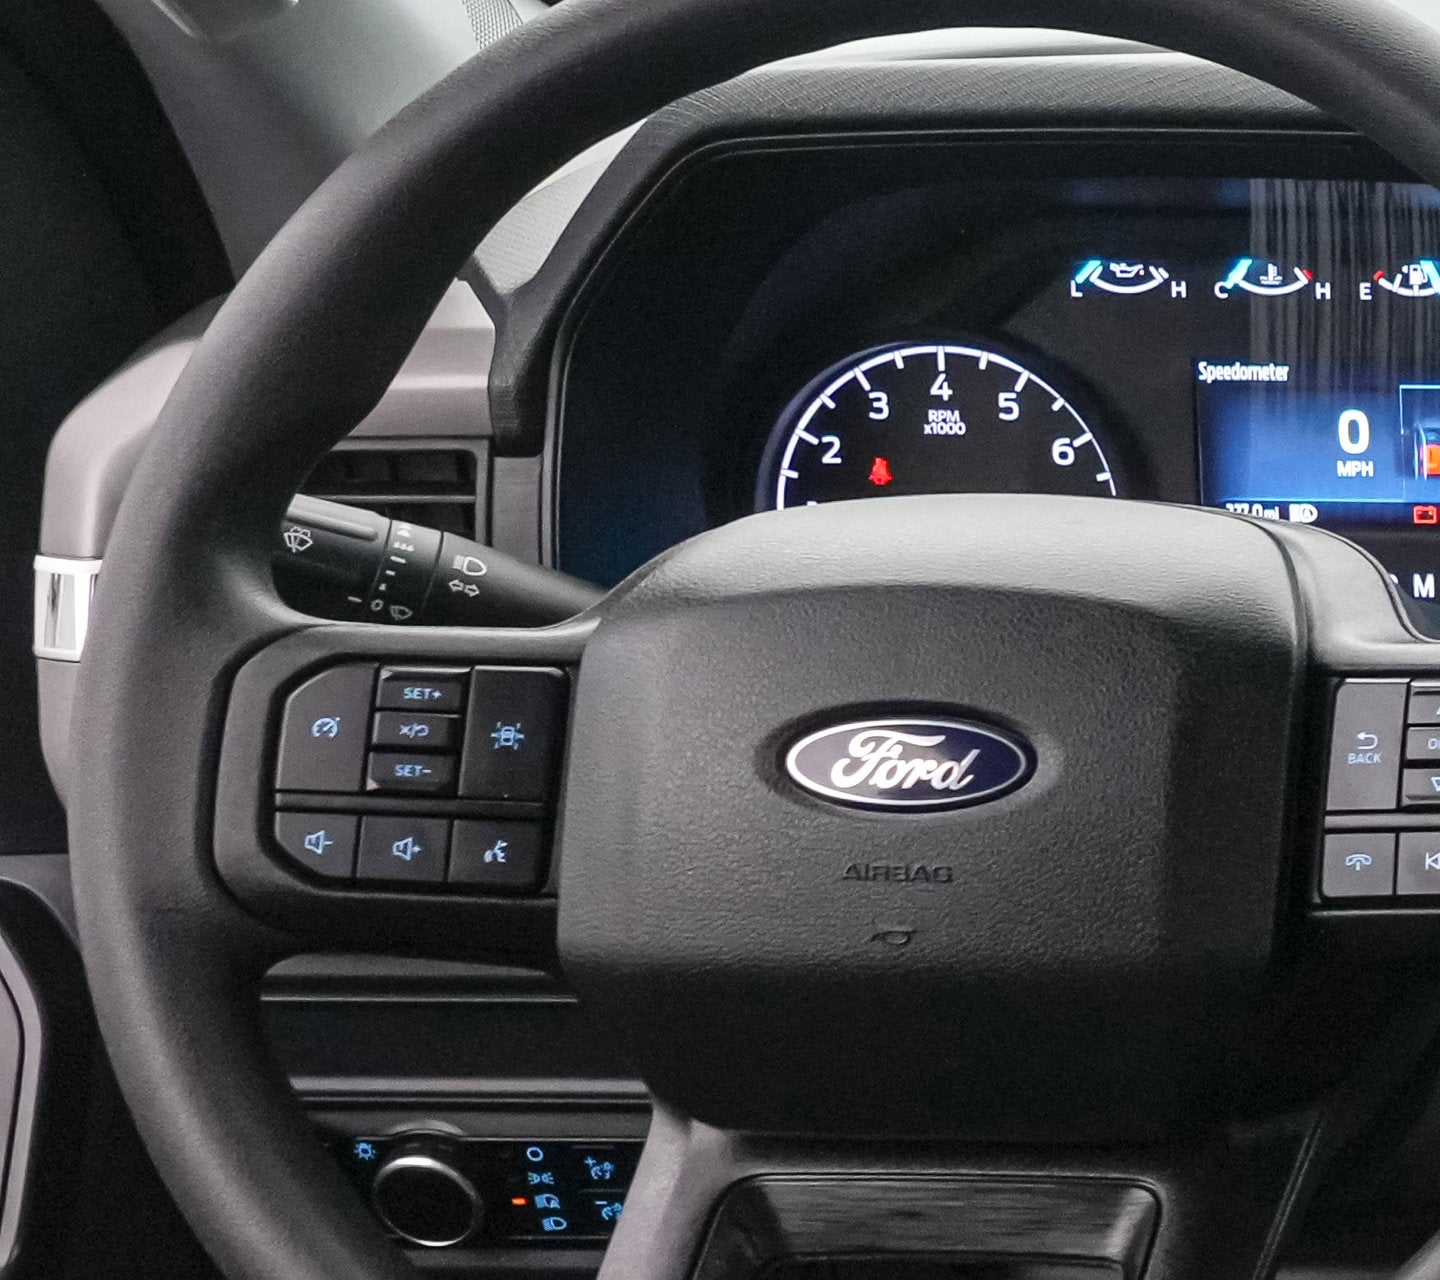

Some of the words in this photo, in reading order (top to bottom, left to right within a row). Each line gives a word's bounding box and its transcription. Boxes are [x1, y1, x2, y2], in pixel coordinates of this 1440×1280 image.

[1070, 281, 1083, 298] L
[1171, 281, 1186, 297] H
[1316, 282, 1330, 299] H
[1360, 283, 1372, 300] E
[1198, 362, 1289, 383] Speedometer
[930, 373, 952, 401] 4
[866, 390, 889, 419] 3
[928, 409, 960, 422] RPM
[998, 391, 1020, 420] 5
[923, 422, 967, 436] x1000
[1337, 410, 1370, 455] 0
[821, 435, 841, 463] 2
[1051, 437, 1076, 466] 6
[1337, 460, 1374, 478] MPH
[1413, 574, 1435, 598] M
[830, 729, 981, 791] Ford
[1347, 752, 1382, 764] BACK
[842, 862, 954, 885] AIRBAG
